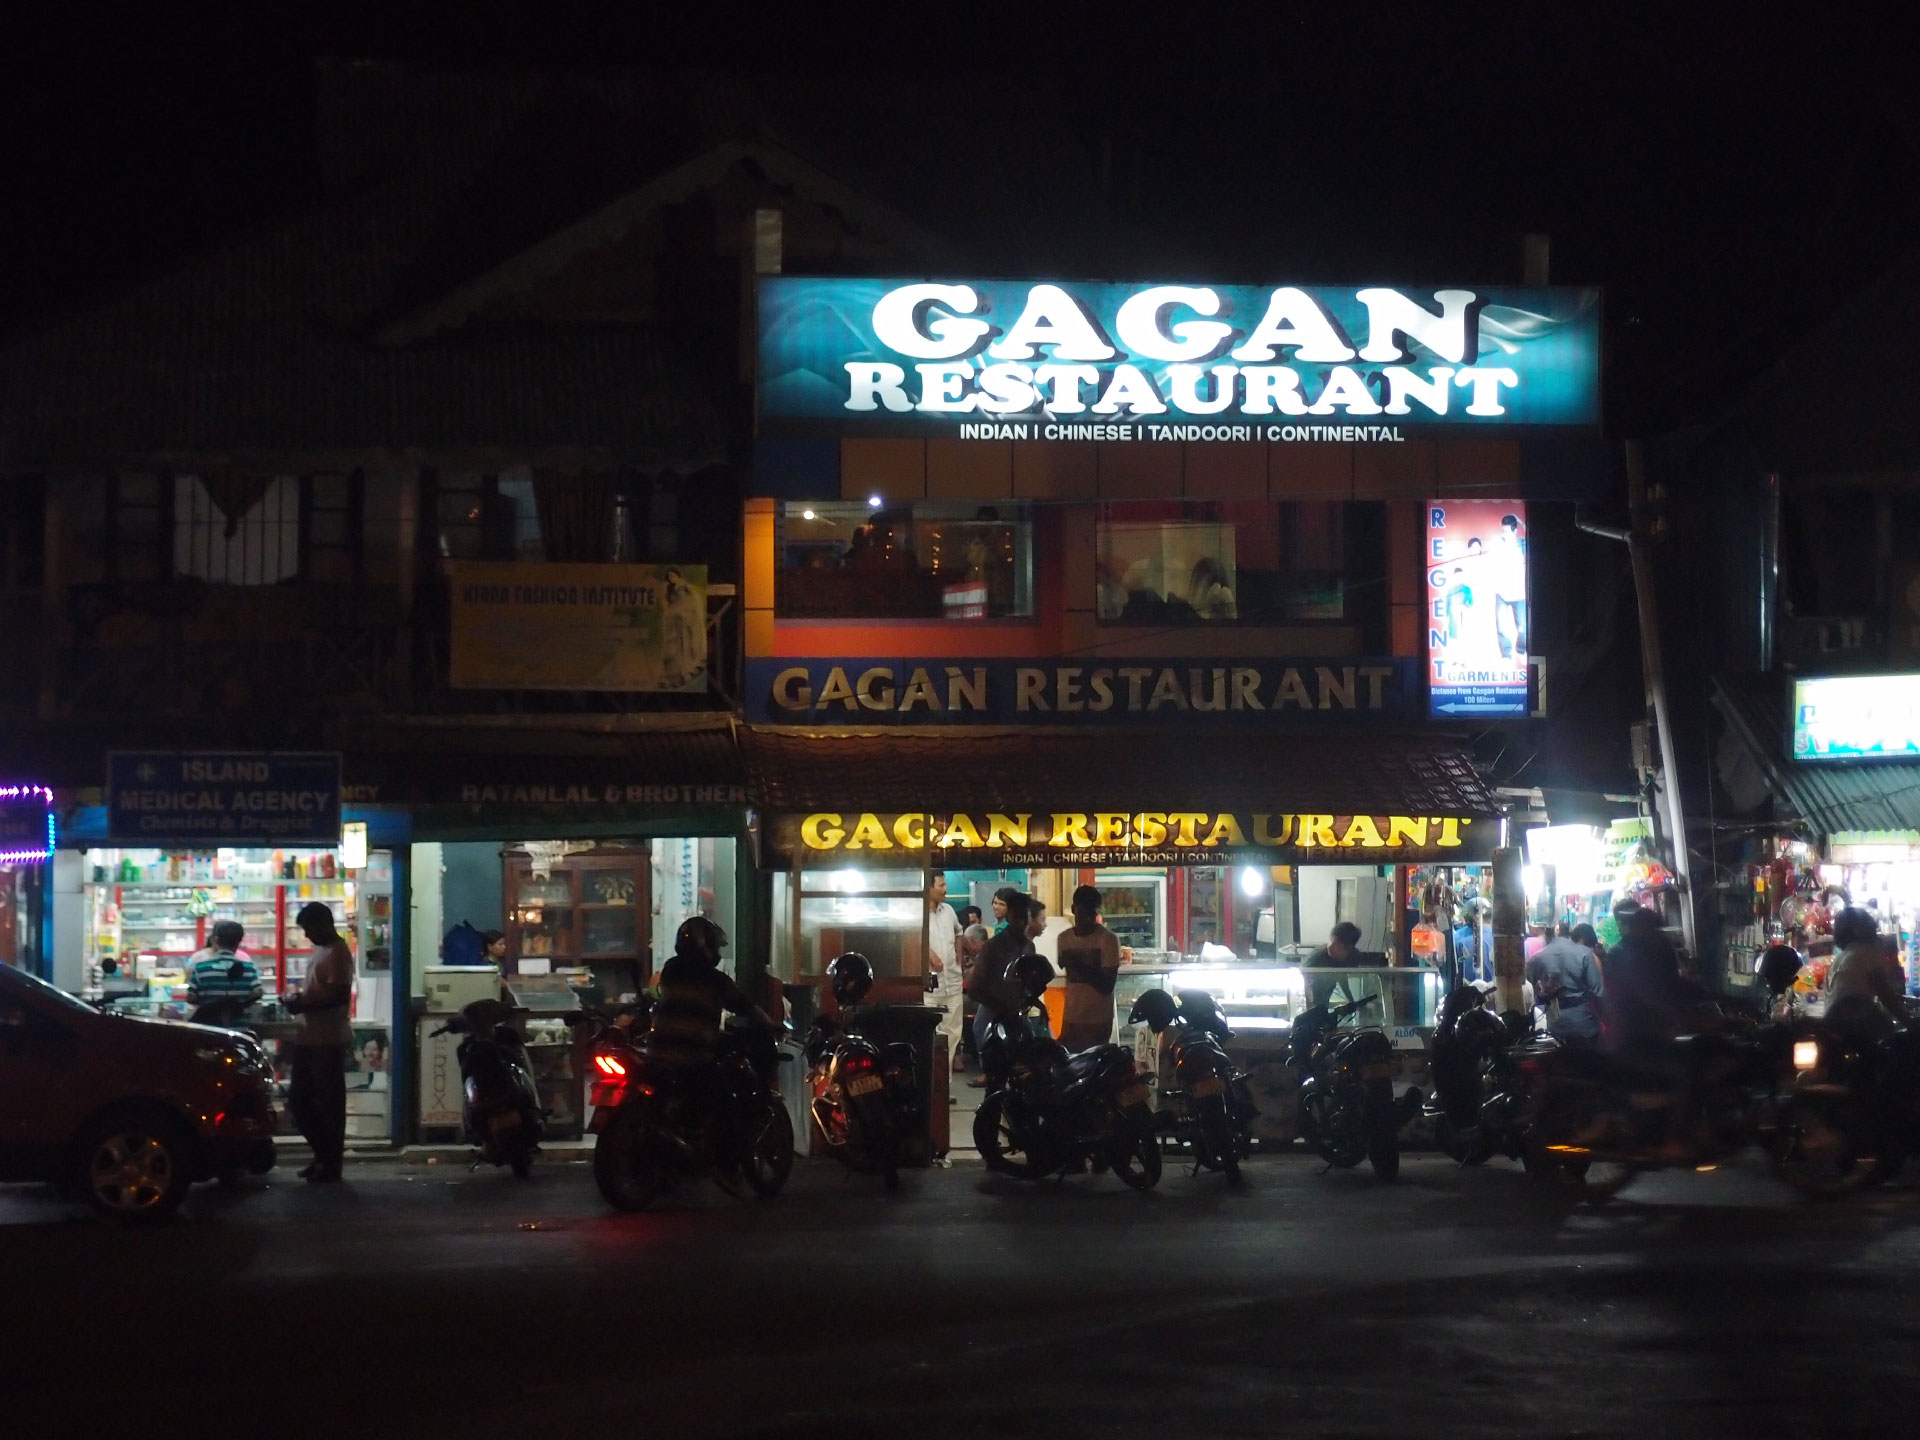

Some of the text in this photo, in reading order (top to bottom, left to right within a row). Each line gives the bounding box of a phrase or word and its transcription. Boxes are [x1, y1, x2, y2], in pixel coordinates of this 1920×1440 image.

[870, 282, 1482, 364] GAGAN
[843, 361, 1519, 416] RESTAURANT
[959, 423, 1404, 443] INDIAN CHINESE TANDOORI CONTINENTAL
[583, 586, 655, 606] INSTITUTE
[1429, 507, 1448, 679] REGENT
[1447, 670, 1528, 682] GARMENTS
[772, 665, 1394, 713] GAGAN RESTAURANT
[1464, 696, 1475, 704] 100
[181, 760, 270, 782] ISLAND
[120, 790, 330, 813] MEDICAL AGENCY
[462, 784, 599, 803] RATANLAL
[800, 811, 1472, 851] GAGAN RESTAURANT
[1002, 852, 1044, 864] INDIAN
[1053, 852, 1106, 864] CHINESE
[1116, 852, 1177, 864] TANDOORI
